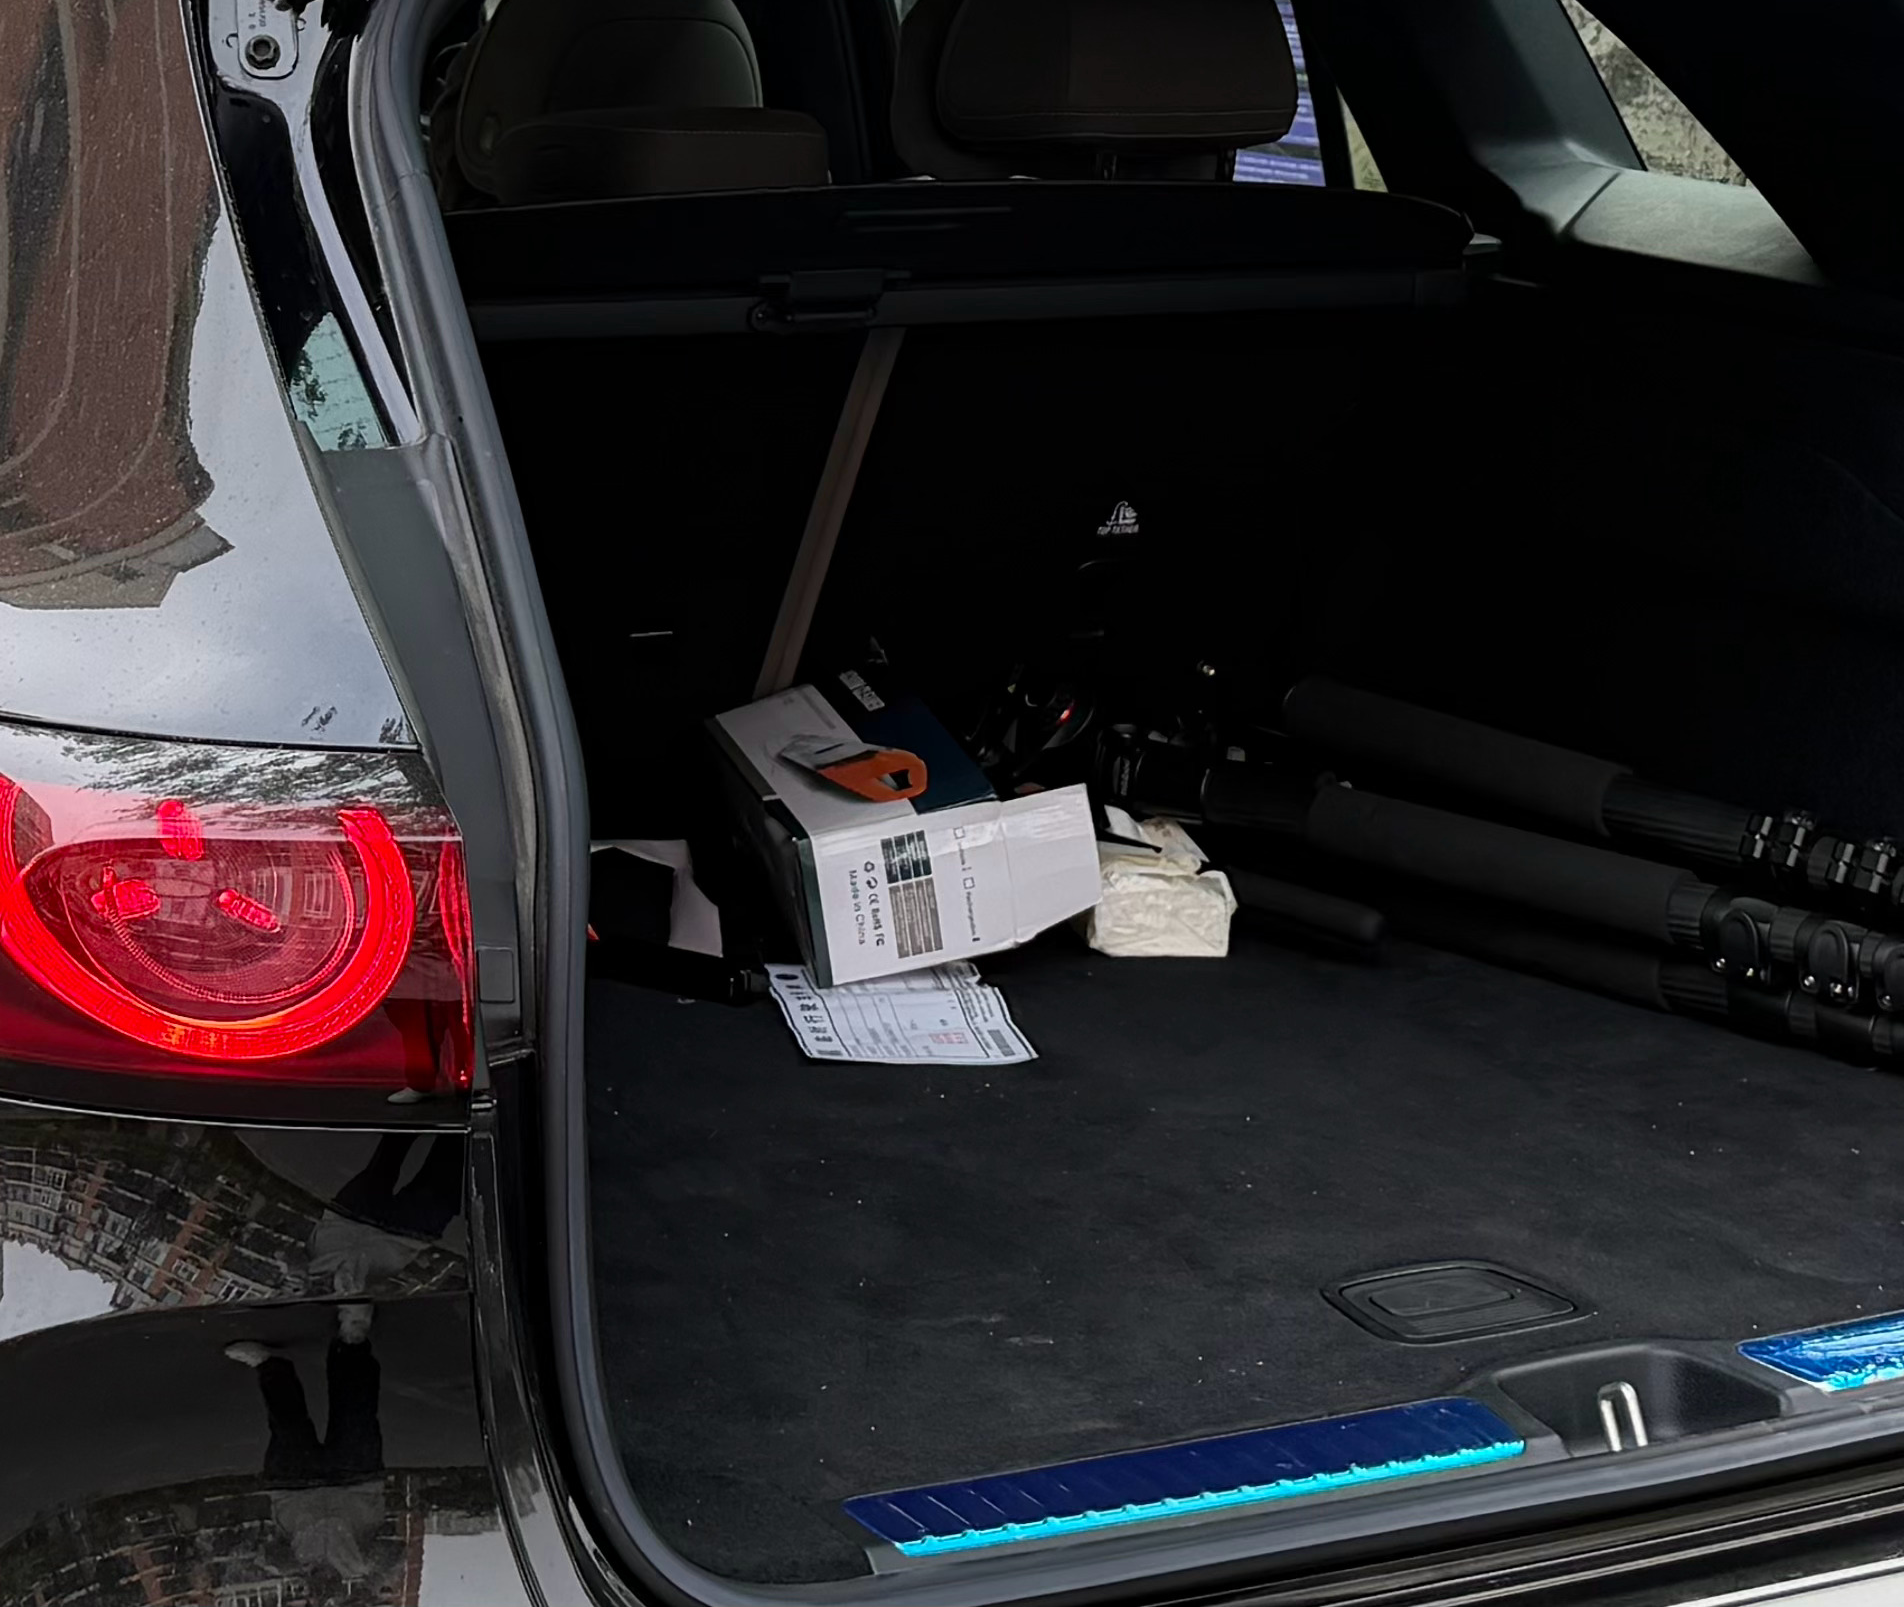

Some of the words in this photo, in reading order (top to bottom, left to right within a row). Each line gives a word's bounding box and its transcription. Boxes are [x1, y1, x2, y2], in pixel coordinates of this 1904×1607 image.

[849, 869, 859, 901] Made
[853, 900, 862, 913] in
[855, 913, 867, 946] China
